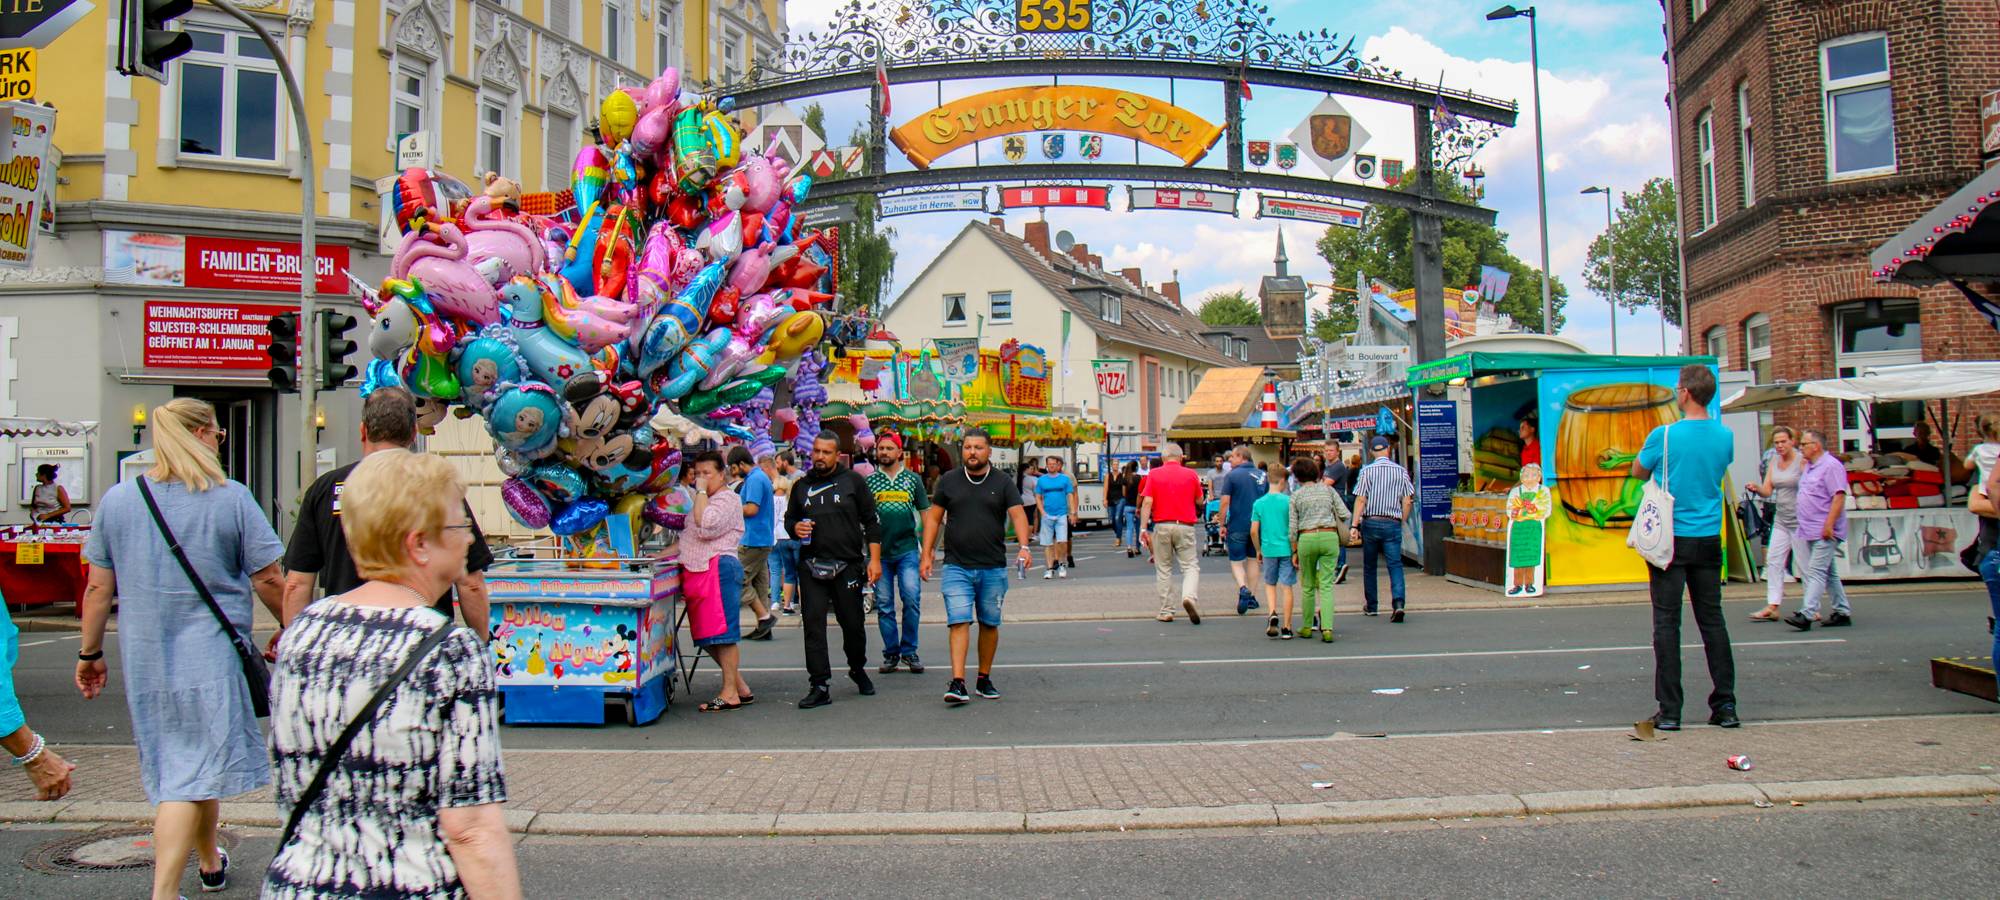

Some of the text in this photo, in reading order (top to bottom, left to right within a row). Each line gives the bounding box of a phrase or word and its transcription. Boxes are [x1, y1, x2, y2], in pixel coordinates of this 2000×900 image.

[1018, 0, 1091, 31] 535
[922, 92, 1192, 144] Cranger Tor
[884, 200, 956, 214] Zuhause in Herne.
[201, 250, 334, 276] FAMILIEN-BRUCH
[149, 306, 239, 320] WEIHNACHTSBUFFET
[149, 336, 195, 349] GEÖFFNET
[195, 338, 209, 349] AM
[212, 339, 220, 349] 1.
[221, 339, 255, 350] JANUAR
[1358, 352, 1398, 361] Boulevard
[1096, 372, 1126, 395] PIZZA
